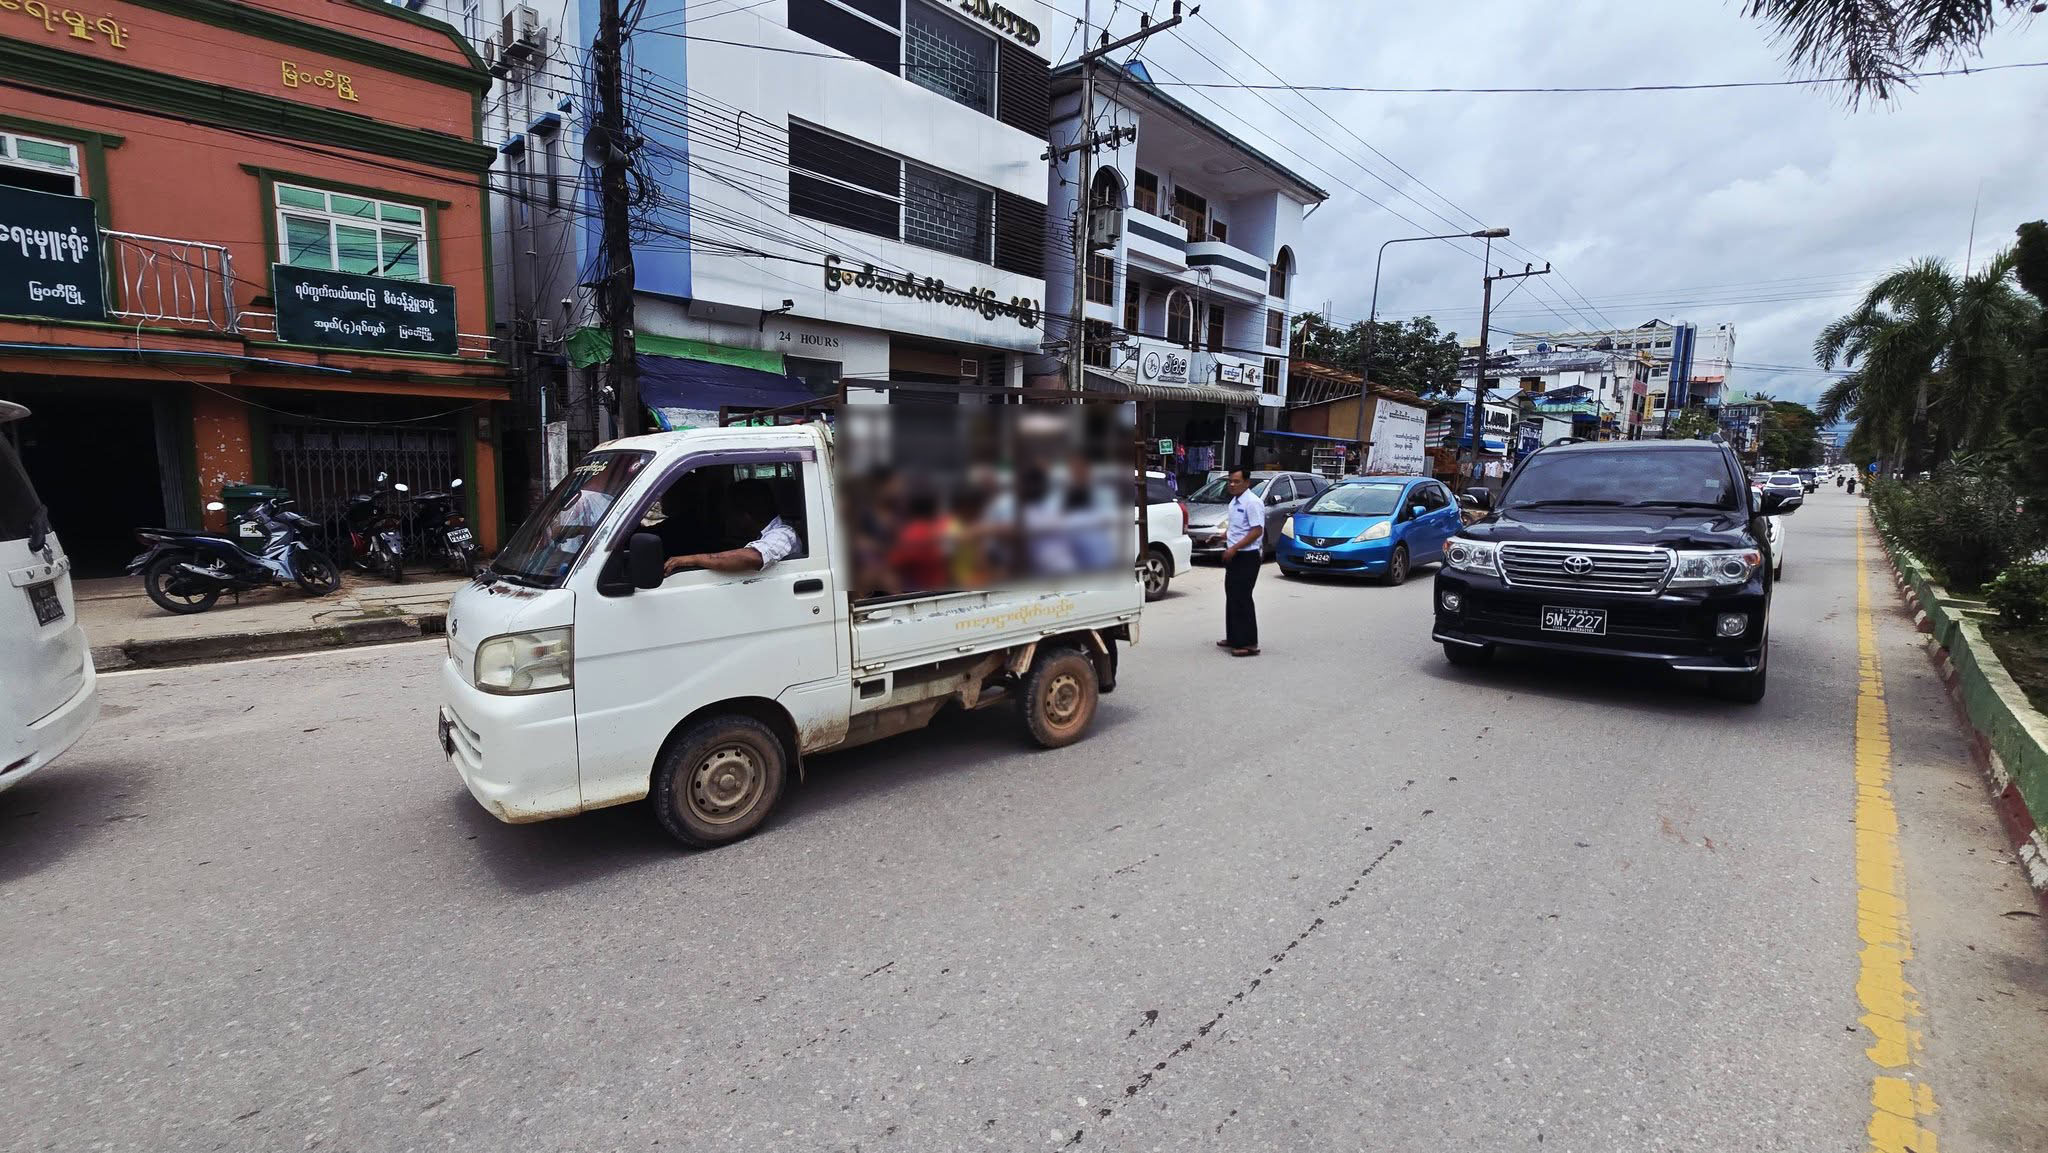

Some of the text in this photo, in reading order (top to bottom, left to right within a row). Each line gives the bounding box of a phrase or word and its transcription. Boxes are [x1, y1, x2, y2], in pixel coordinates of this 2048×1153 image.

[281, 60, 359, 102] မြဝတီမြို့
[28, 280, 86, 305] မြဝတီမြို့
[779, 330, 839, 348] 24 HOURS
[1545, 612, 1603, 629] 5M-7227
